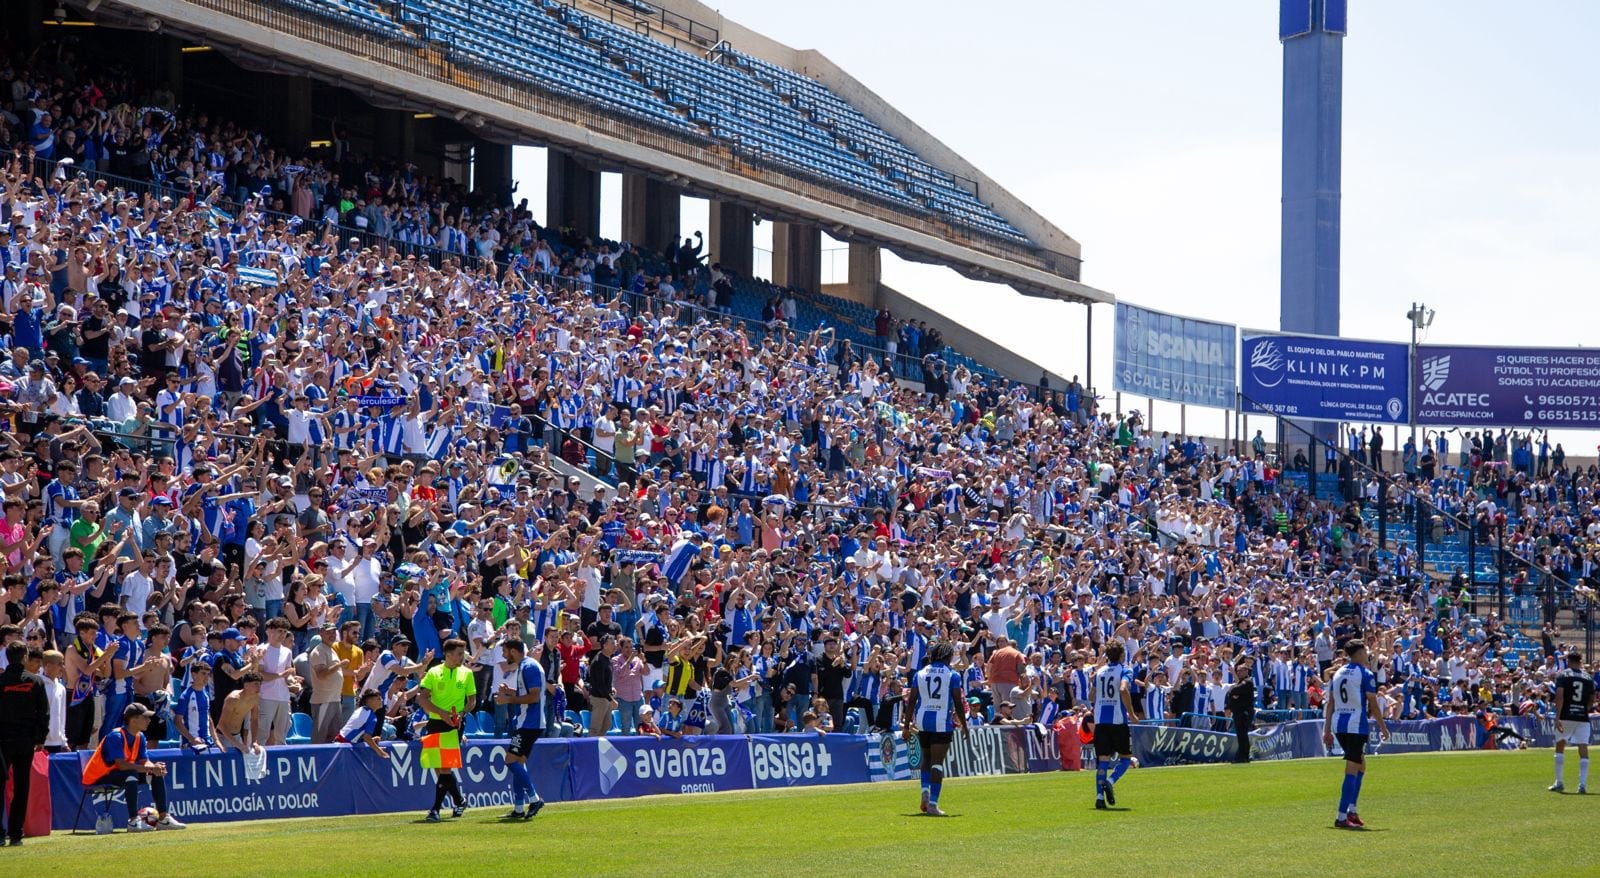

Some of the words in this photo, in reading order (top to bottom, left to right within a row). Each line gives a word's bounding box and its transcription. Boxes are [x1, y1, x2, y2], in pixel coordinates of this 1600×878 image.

[1148, 329, 1224, 366] SCANIA
[1295, 346, 1315, 354] EQUIPO
[1315, 348, 1326, 356] DEL
[1337, 350, 1355, 358] PABLO
[1356, 351, 1385, 360] MARTÍNEZ
[1497, 355, 1506, 364] SI
[1507, 355, 1549, 365] QUIERES
[1550, 356, 1585, 365] HACER
[1494, 364, 1533, 375] FÚTBOL
[1536, 367, 1548, 375] TU
[1550, 366, 1600, 377] PROFESIÓ
[1123, 370, 1225, 399] SCALEVANTE
[1498, 377, 1534, 387] SOMOS
[1536, 378, 1549, 387] TU
[1320, 400, 1339, 408] CLÍNICA
[1422, 392, 1490, 406] ACATEC
[1538, 395, 1600, 406] 9650571
[1274, 404, 1286, 412] 367
[1286, 405, 1298, 413] 082
[1419, 410, 1494, 418] ACATECSPAIN.COM
[1537, 410, 1600, 421] 6651515
[925, 676, 942, 699] 12
[1101, 676, 1115, 698] 16
[1340, 678, 1348, 704] 6
[1572, 681, 1584, 702] 3
[1152, 727, 1229, 759] MARCOS
[635, 747, 727, 779] avanza
[267, 797, 275, 810] Y
[278, 793, 319, 809] DOLOR
